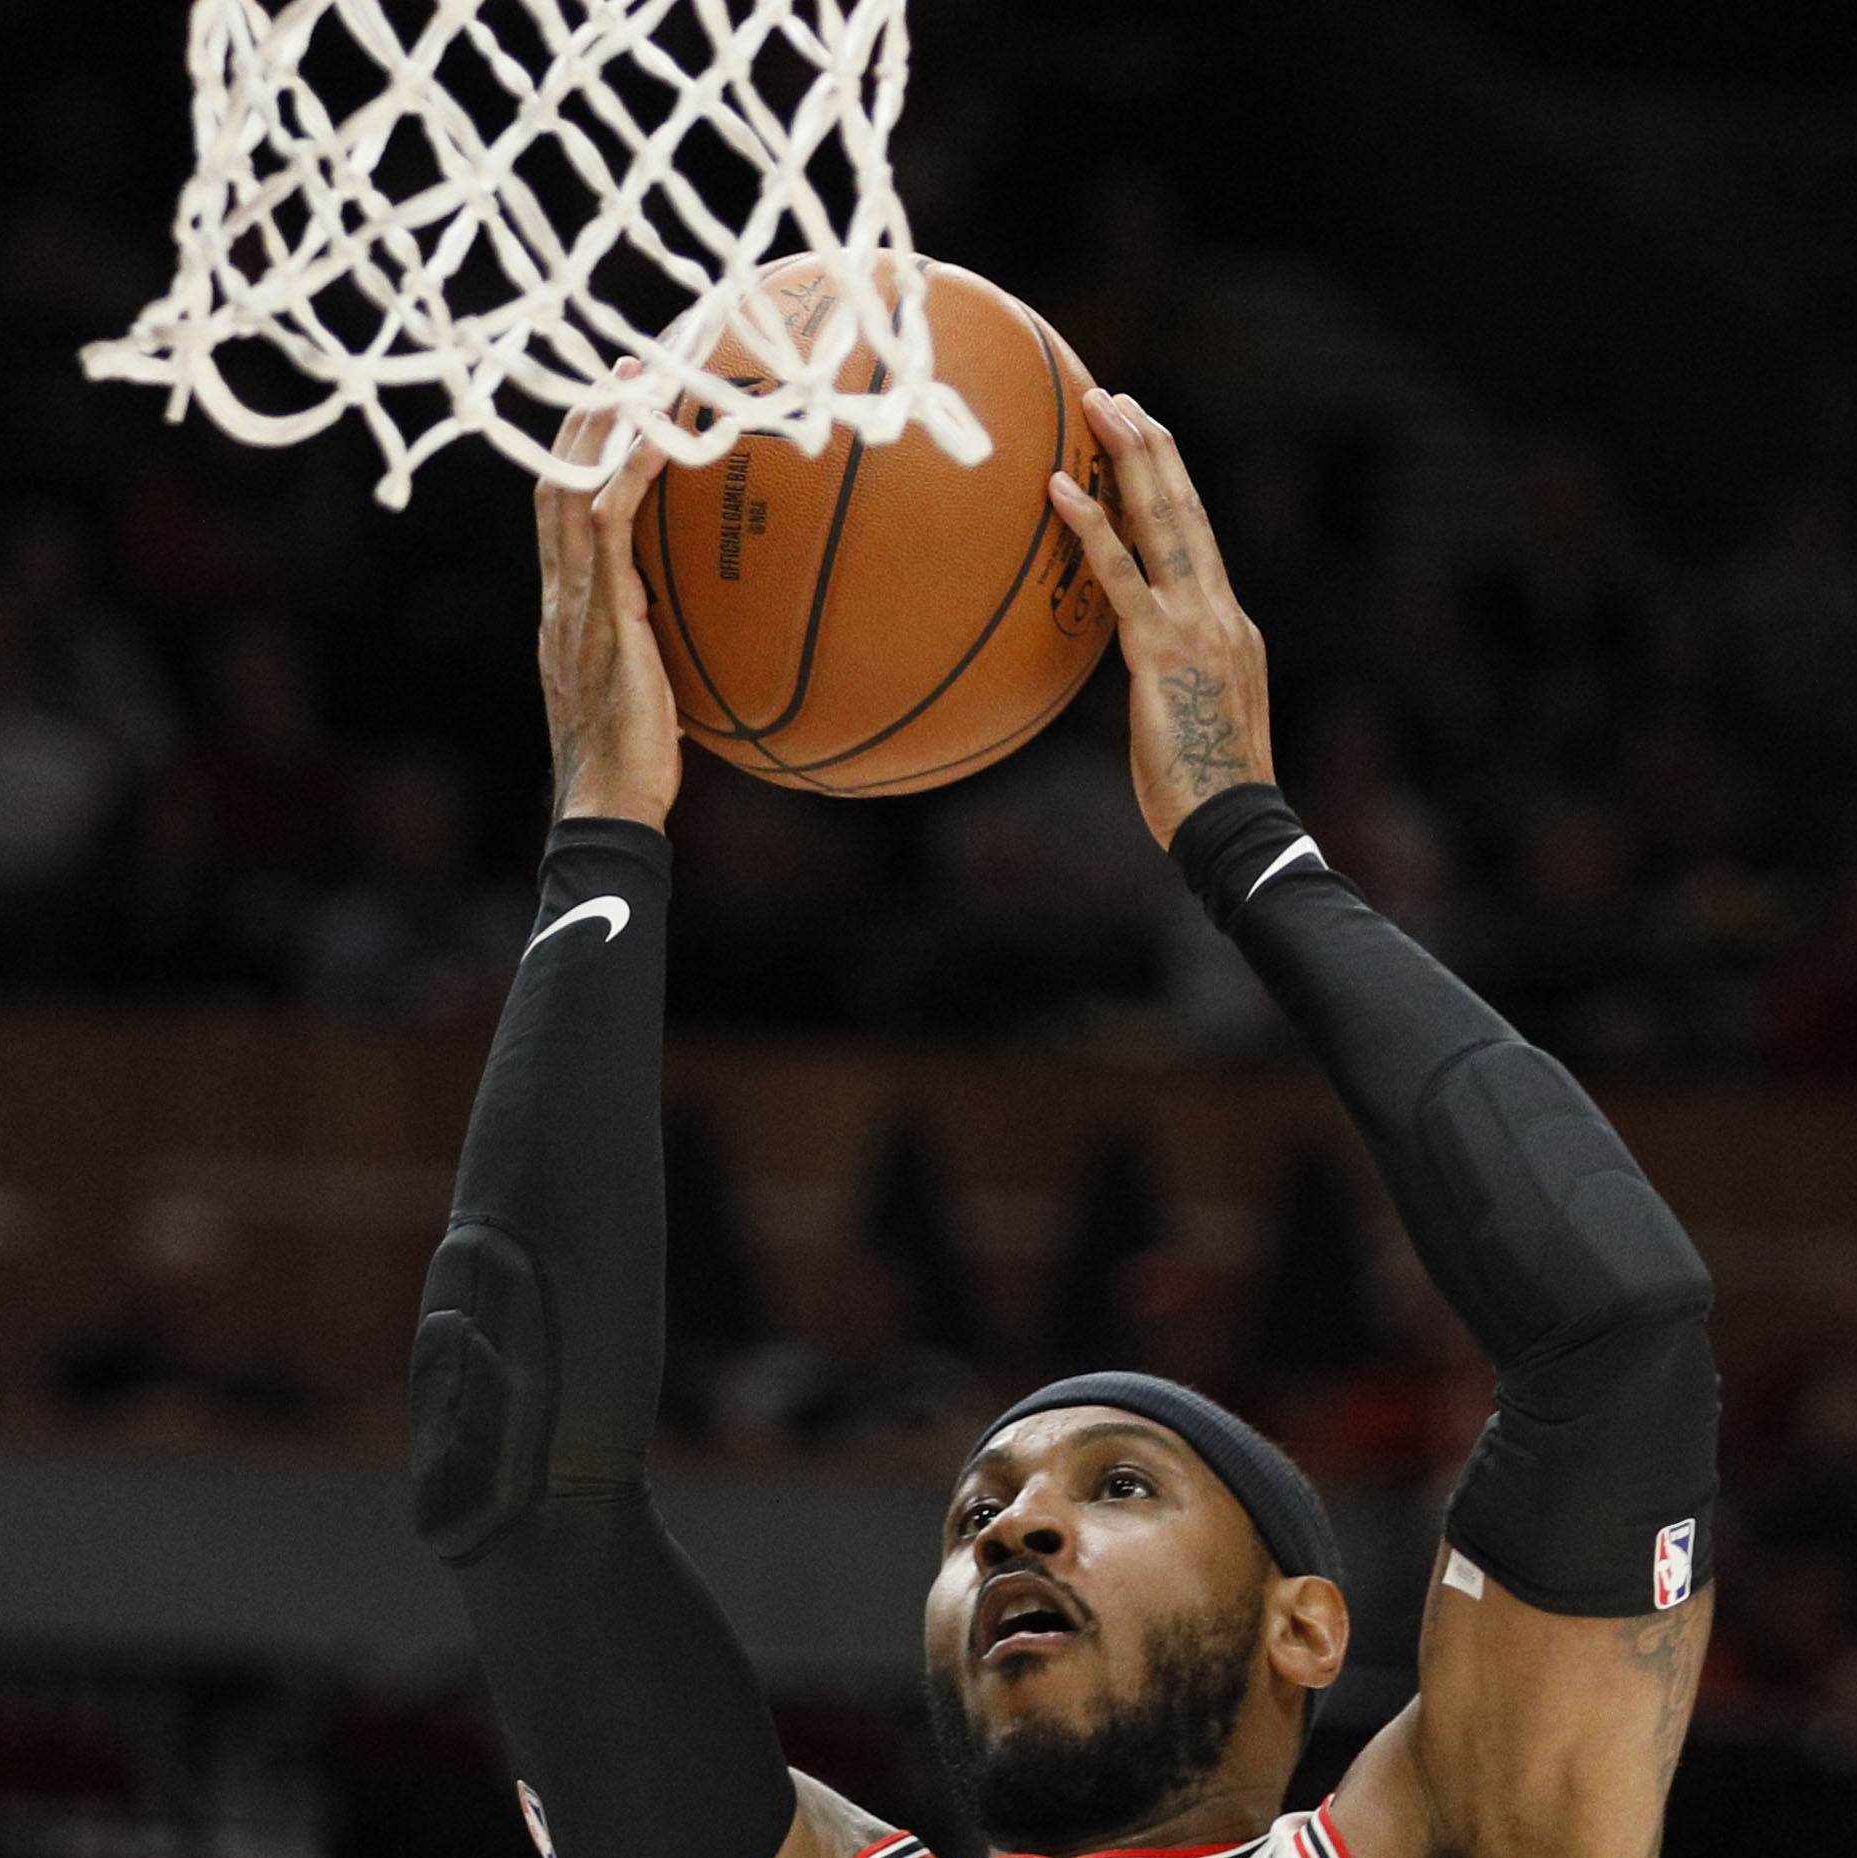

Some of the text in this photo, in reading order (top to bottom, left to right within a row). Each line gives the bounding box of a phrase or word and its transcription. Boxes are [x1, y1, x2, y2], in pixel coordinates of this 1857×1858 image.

[719, 453, 751, 581] OFFICIAL GAME BALL
